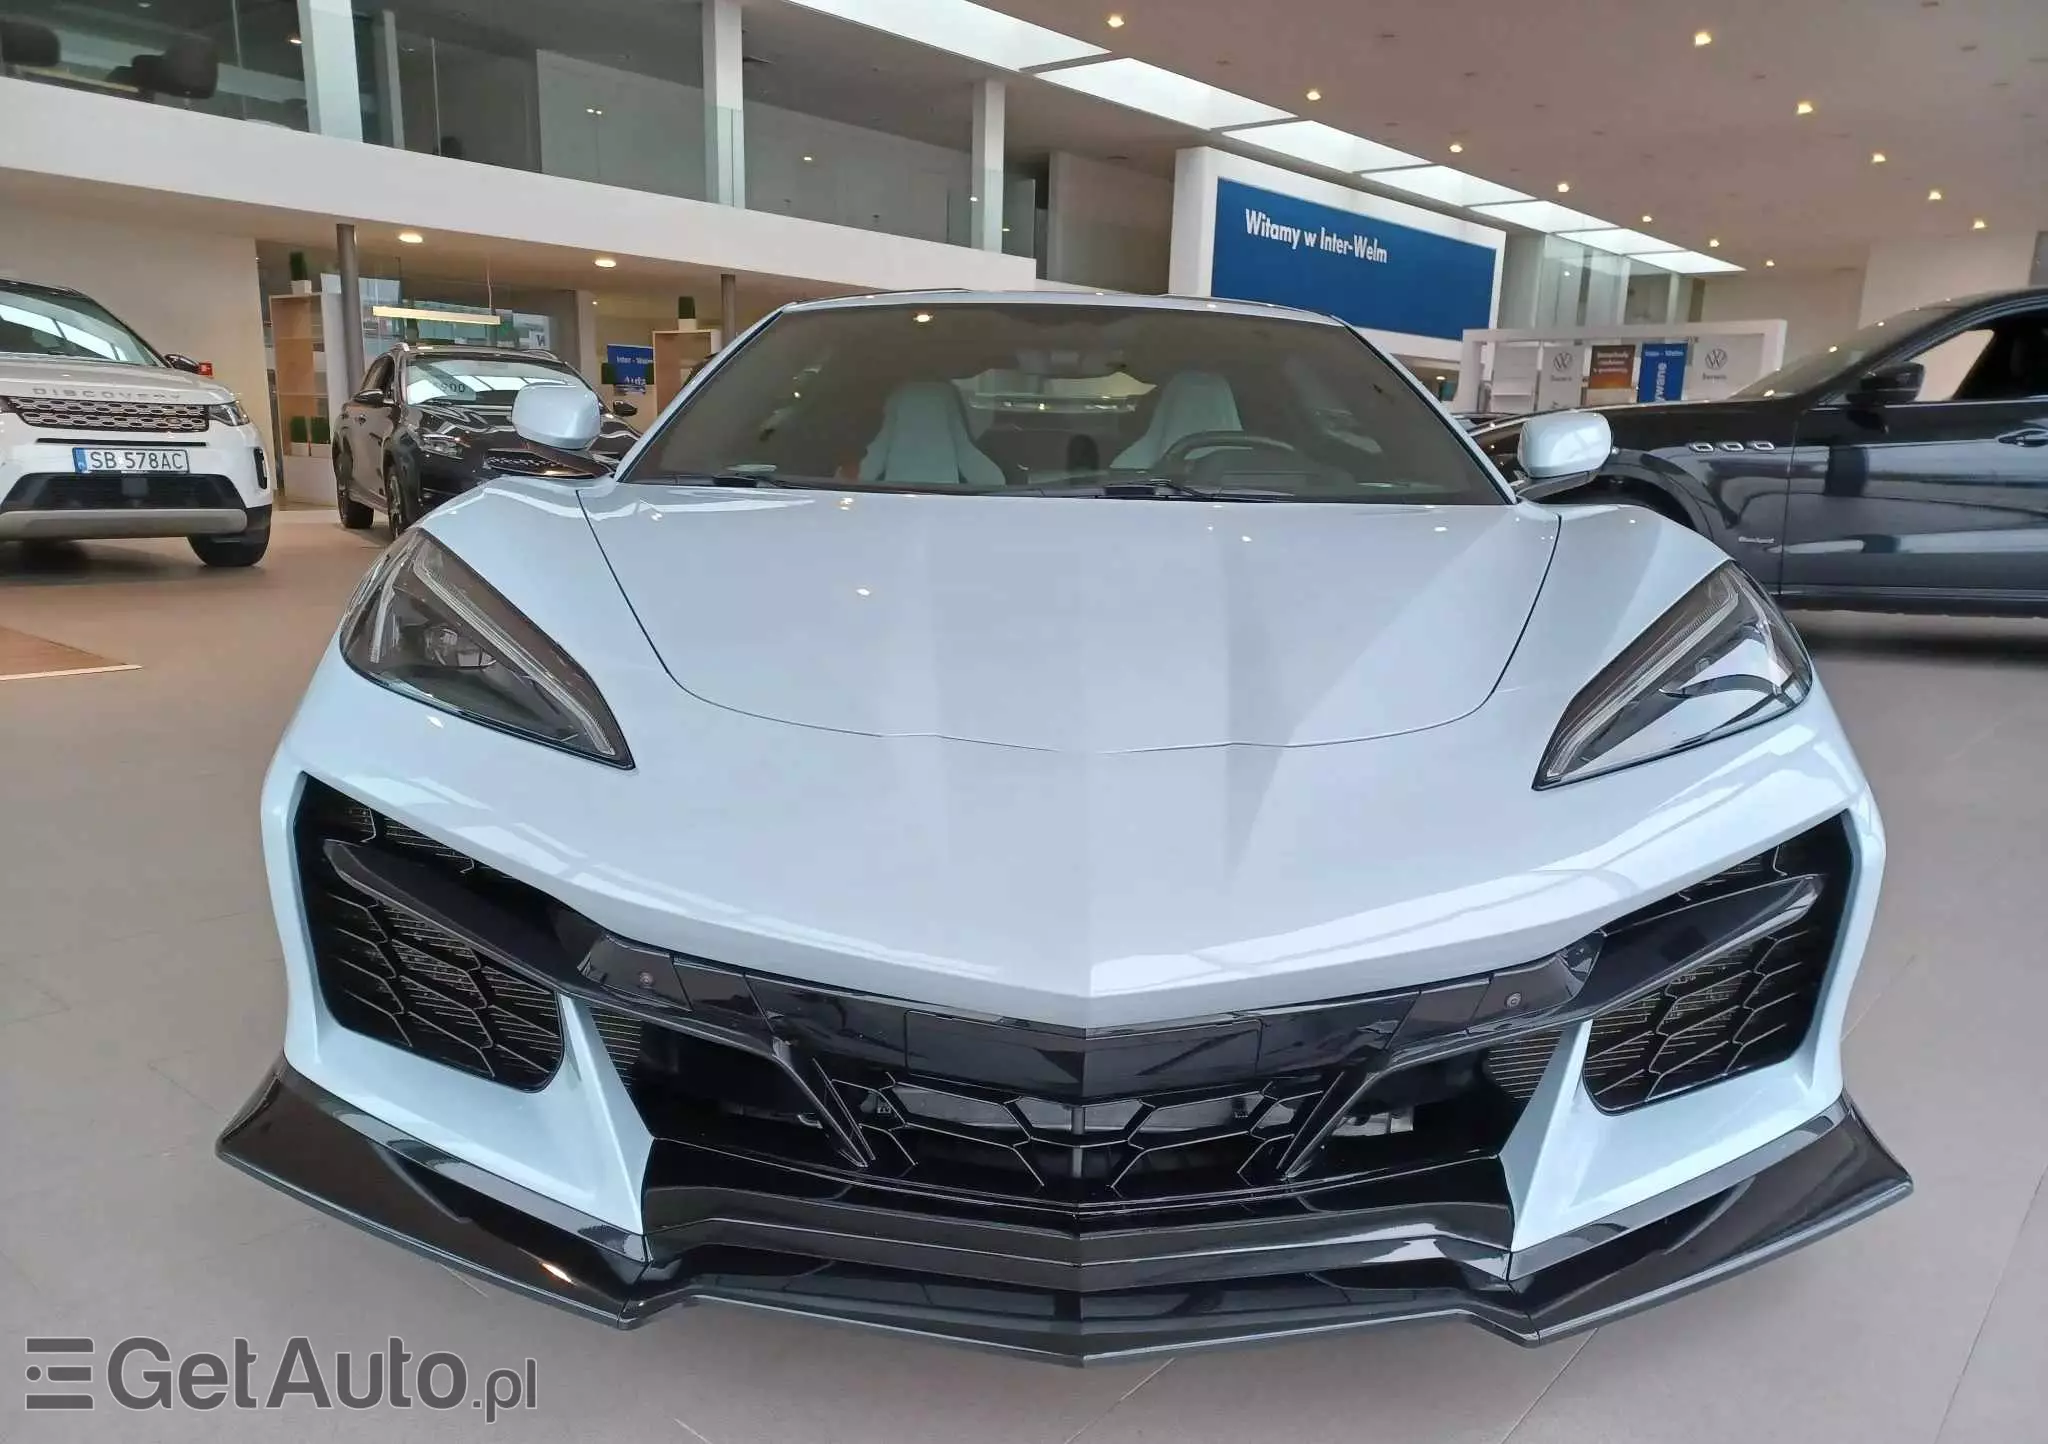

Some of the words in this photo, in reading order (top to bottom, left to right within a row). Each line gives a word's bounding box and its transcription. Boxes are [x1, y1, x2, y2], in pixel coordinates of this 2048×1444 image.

[1245, 208, 1301, 250] Witamy
[1304, 230, 1316, 248] w
[1320, 226, 1388, 264] Inter-Welm
[32, 387, 182, 403] DISCOVERY
[91, 451, 117, 470] SB
[124, 452, 184, 471] 578AC
